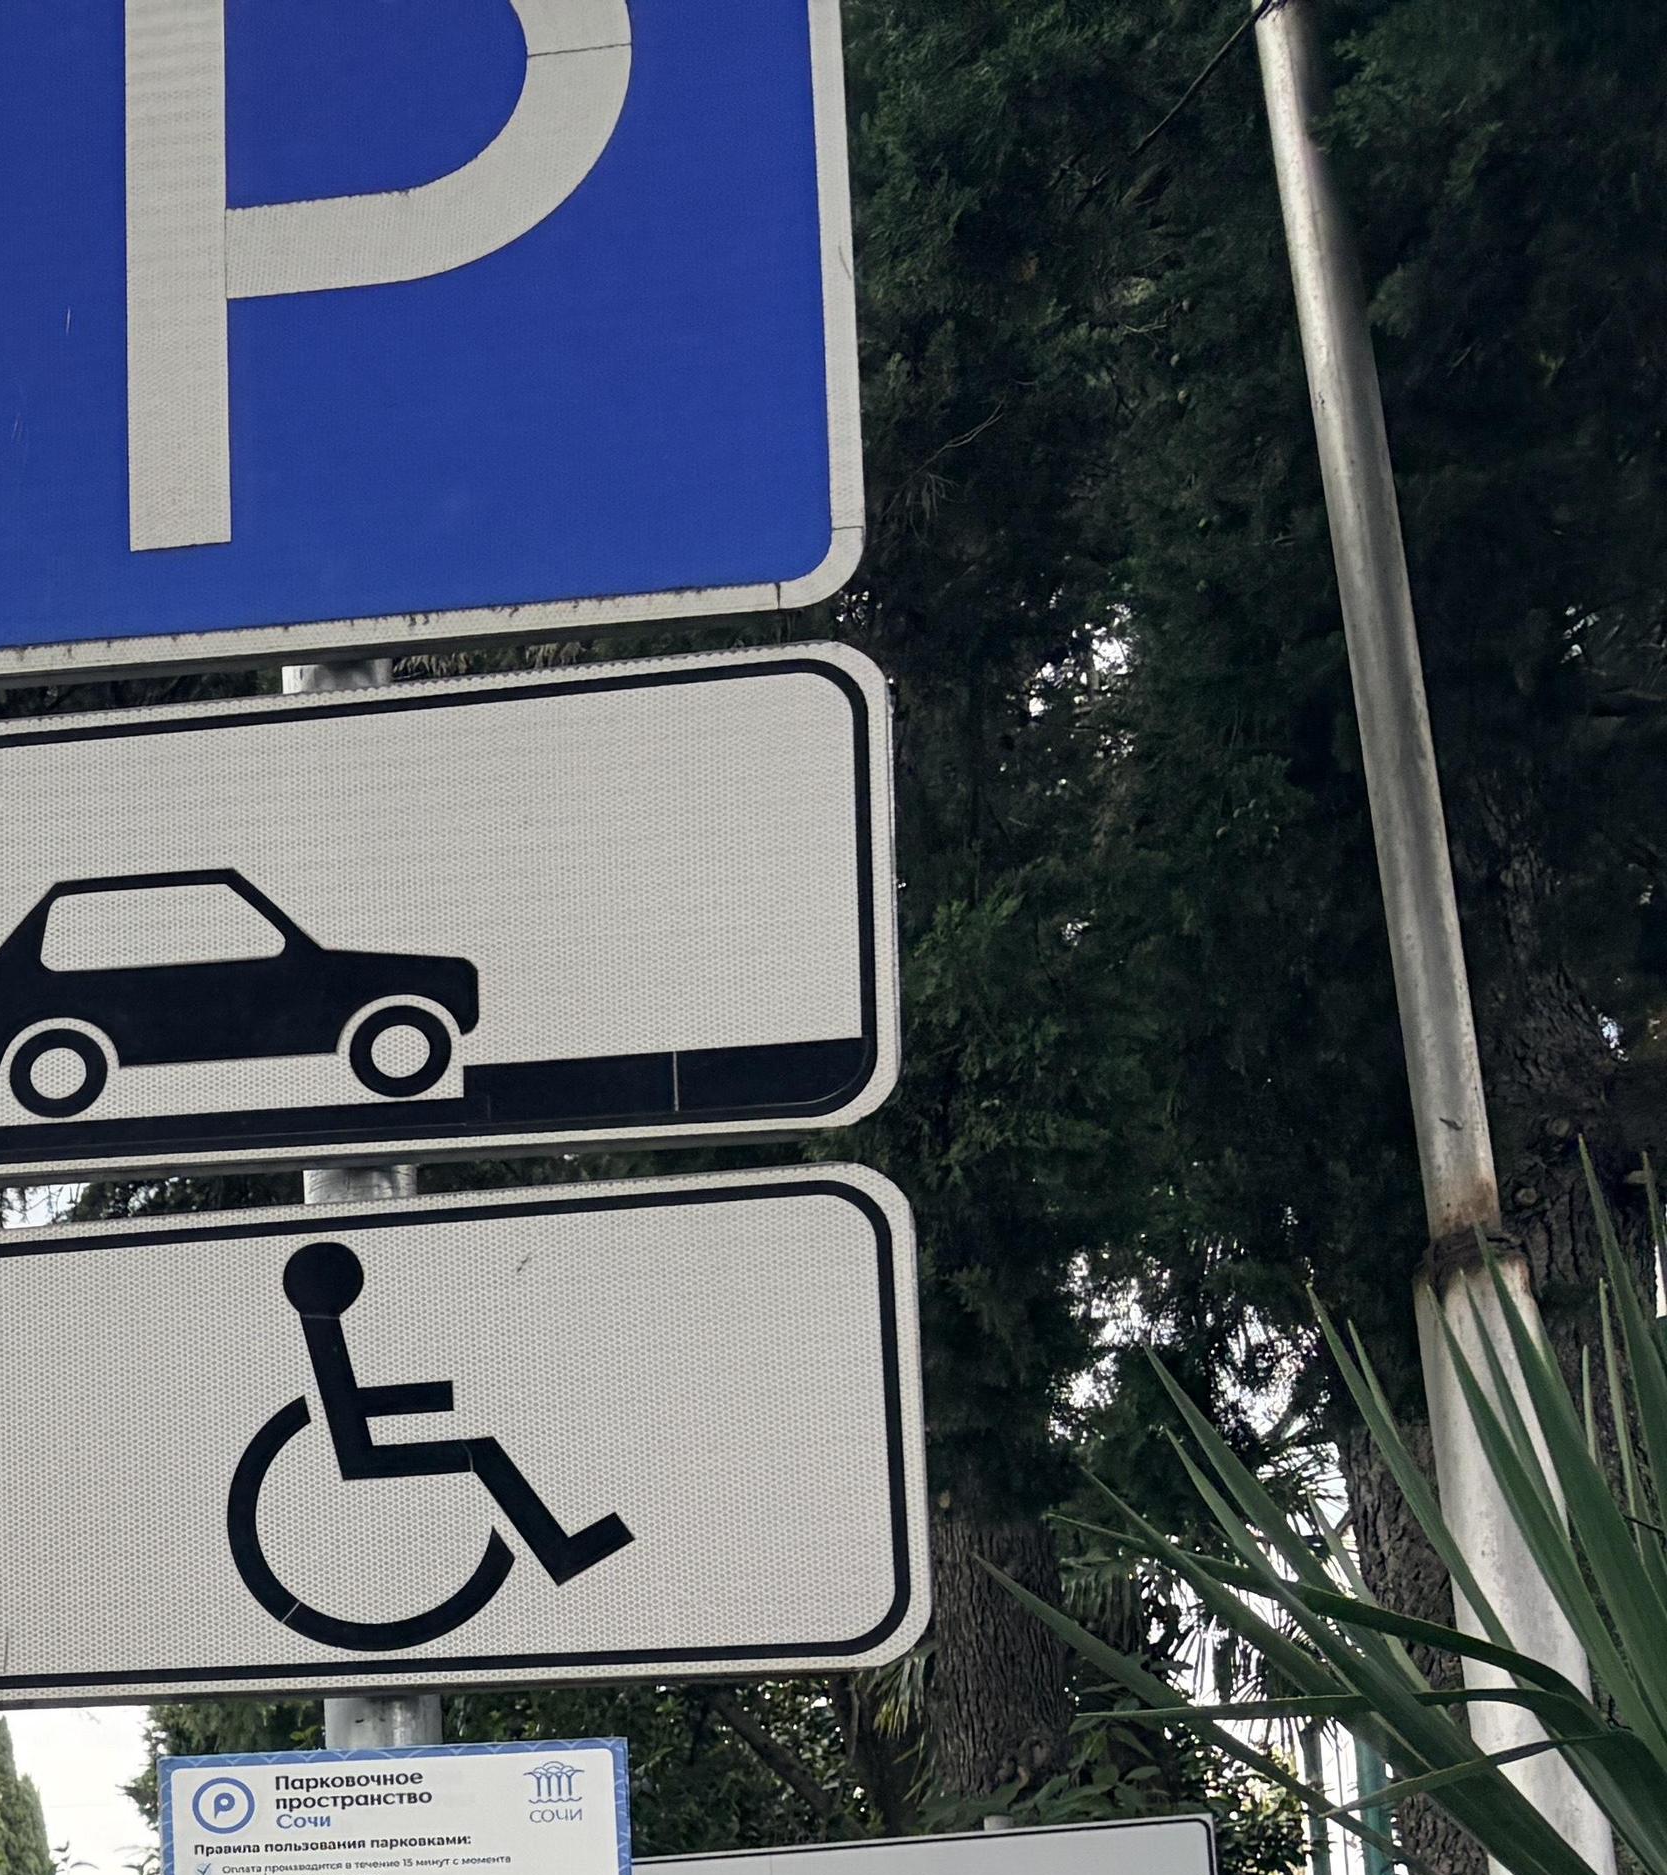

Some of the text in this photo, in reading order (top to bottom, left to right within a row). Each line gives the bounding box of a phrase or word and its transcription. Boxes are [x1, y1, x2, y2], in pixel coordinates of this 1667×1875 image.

[275, 1772, 423, 1792] Парковочное
[275, 1791, 432, 1811] пространство
[276, 1814, 331, 1829] Сочи
[529, 1808, 583, 1823] СОЧИ
[194, 1835, 472, 1857] Правила пользования парковками:
[222, 1865, 262, 1874] Оплата
[264, 1861, 343, 1875] производится
[355, 1860, 400, 1869] течение
[403, 1858, 413, 1867] 15
[416, 1858, 450, 1869] минут
[462, 1855, 511, 1865] момента
